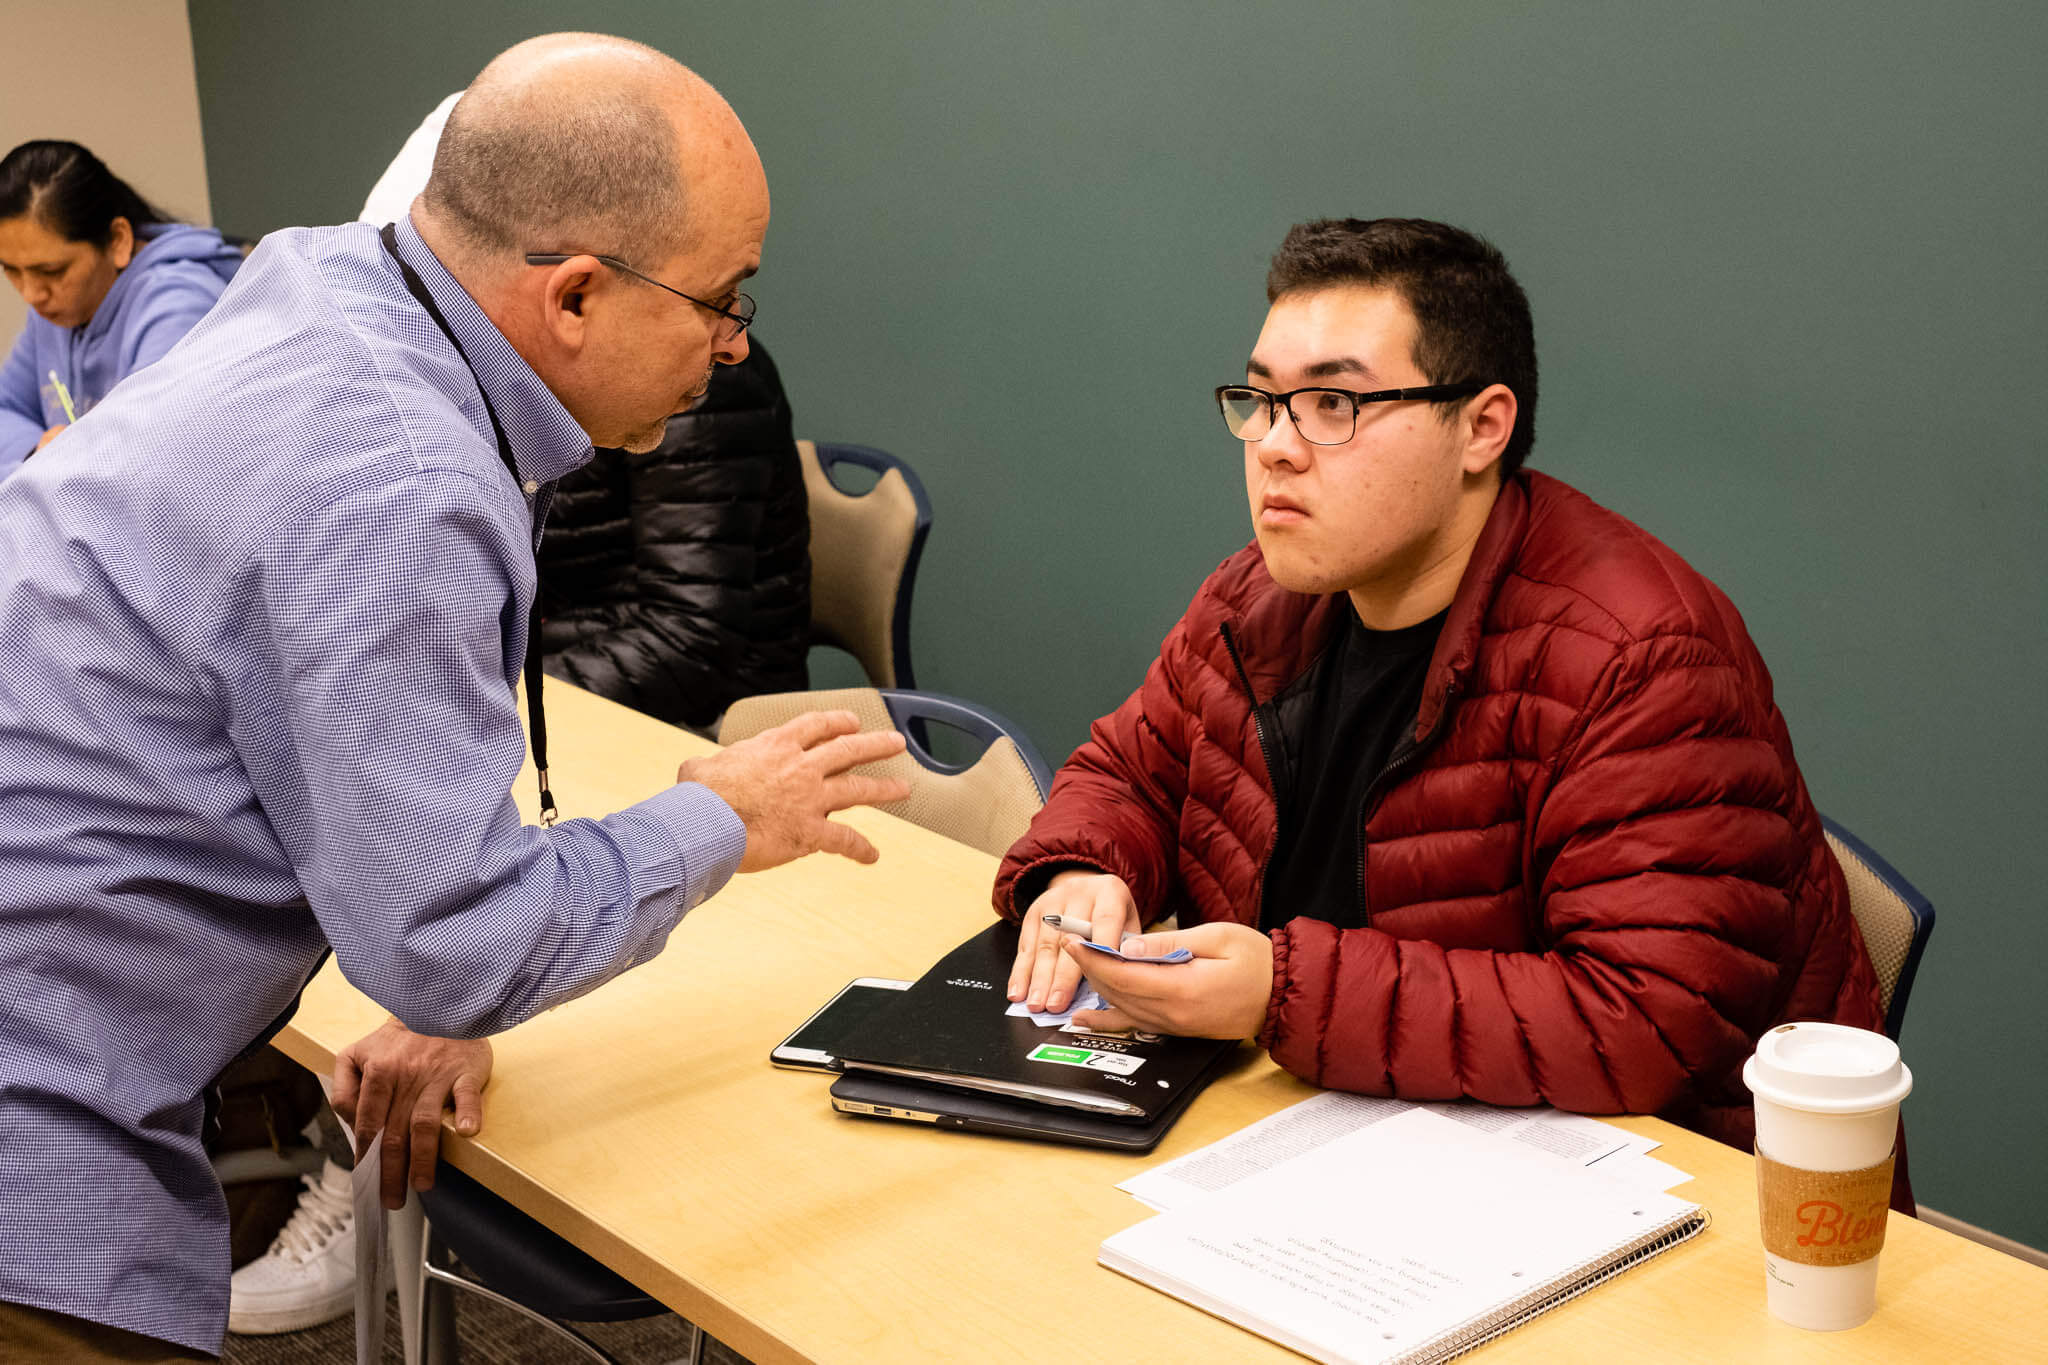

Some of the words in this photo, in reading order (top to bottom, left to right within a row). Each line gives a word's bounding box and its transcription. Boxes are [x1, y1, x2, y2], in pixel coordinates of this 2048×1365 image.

[1072, 1041, 1100, 1049] STAR
[1101, 1045, 1127, 1053] FIVE
[1086, 1054, 1106, 1066] 2
